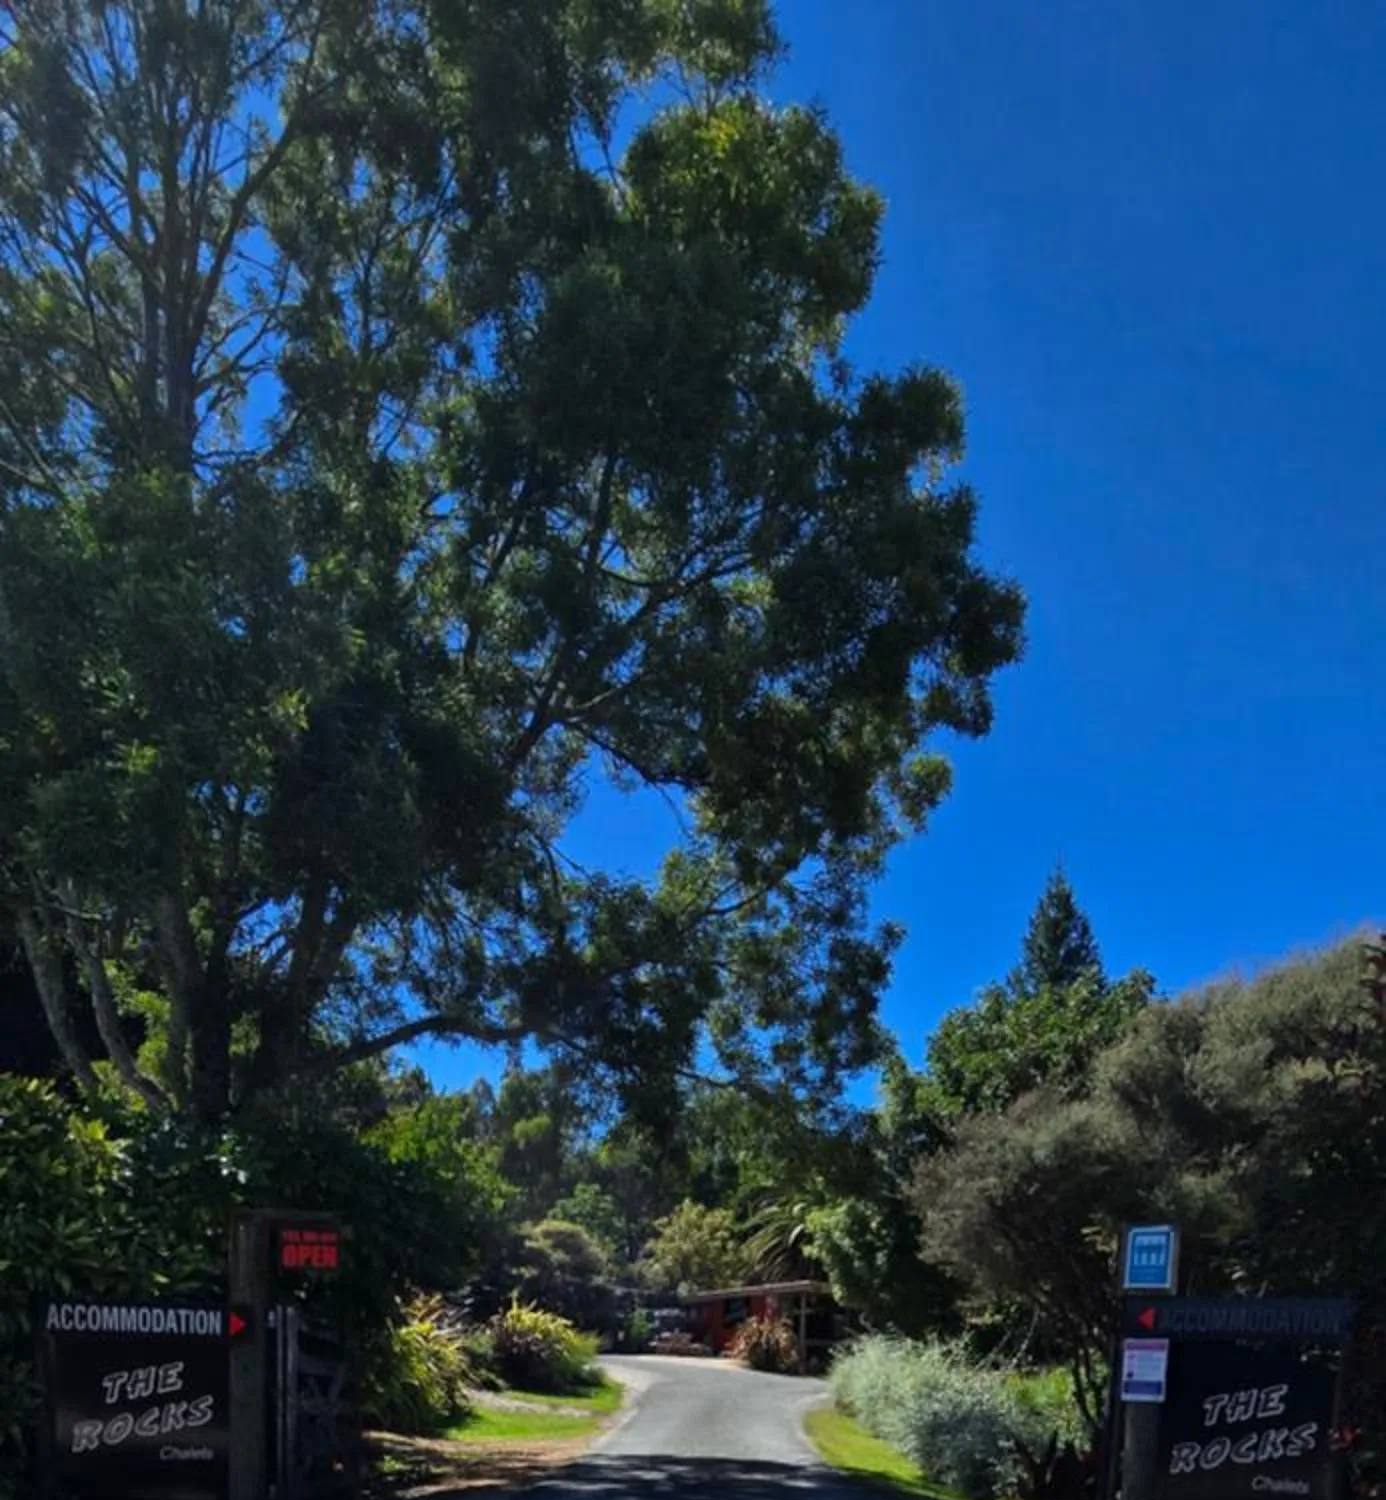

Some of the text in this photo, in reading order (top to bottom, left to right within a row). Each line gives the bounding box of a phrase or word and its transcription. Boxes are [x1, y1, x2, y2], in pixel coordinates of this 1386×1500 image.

[281, 1243, 338, 1268] OPEN
[46, 1303, 222, 1336] ACCOMMODATION
[102, 1361, 184, 1404] THE
[71, 1394, 214, 1453] ROCKS
[1203, 1383, 1289, 1427] THE
[1169, 1421, 1319, 1474] ROCKS
